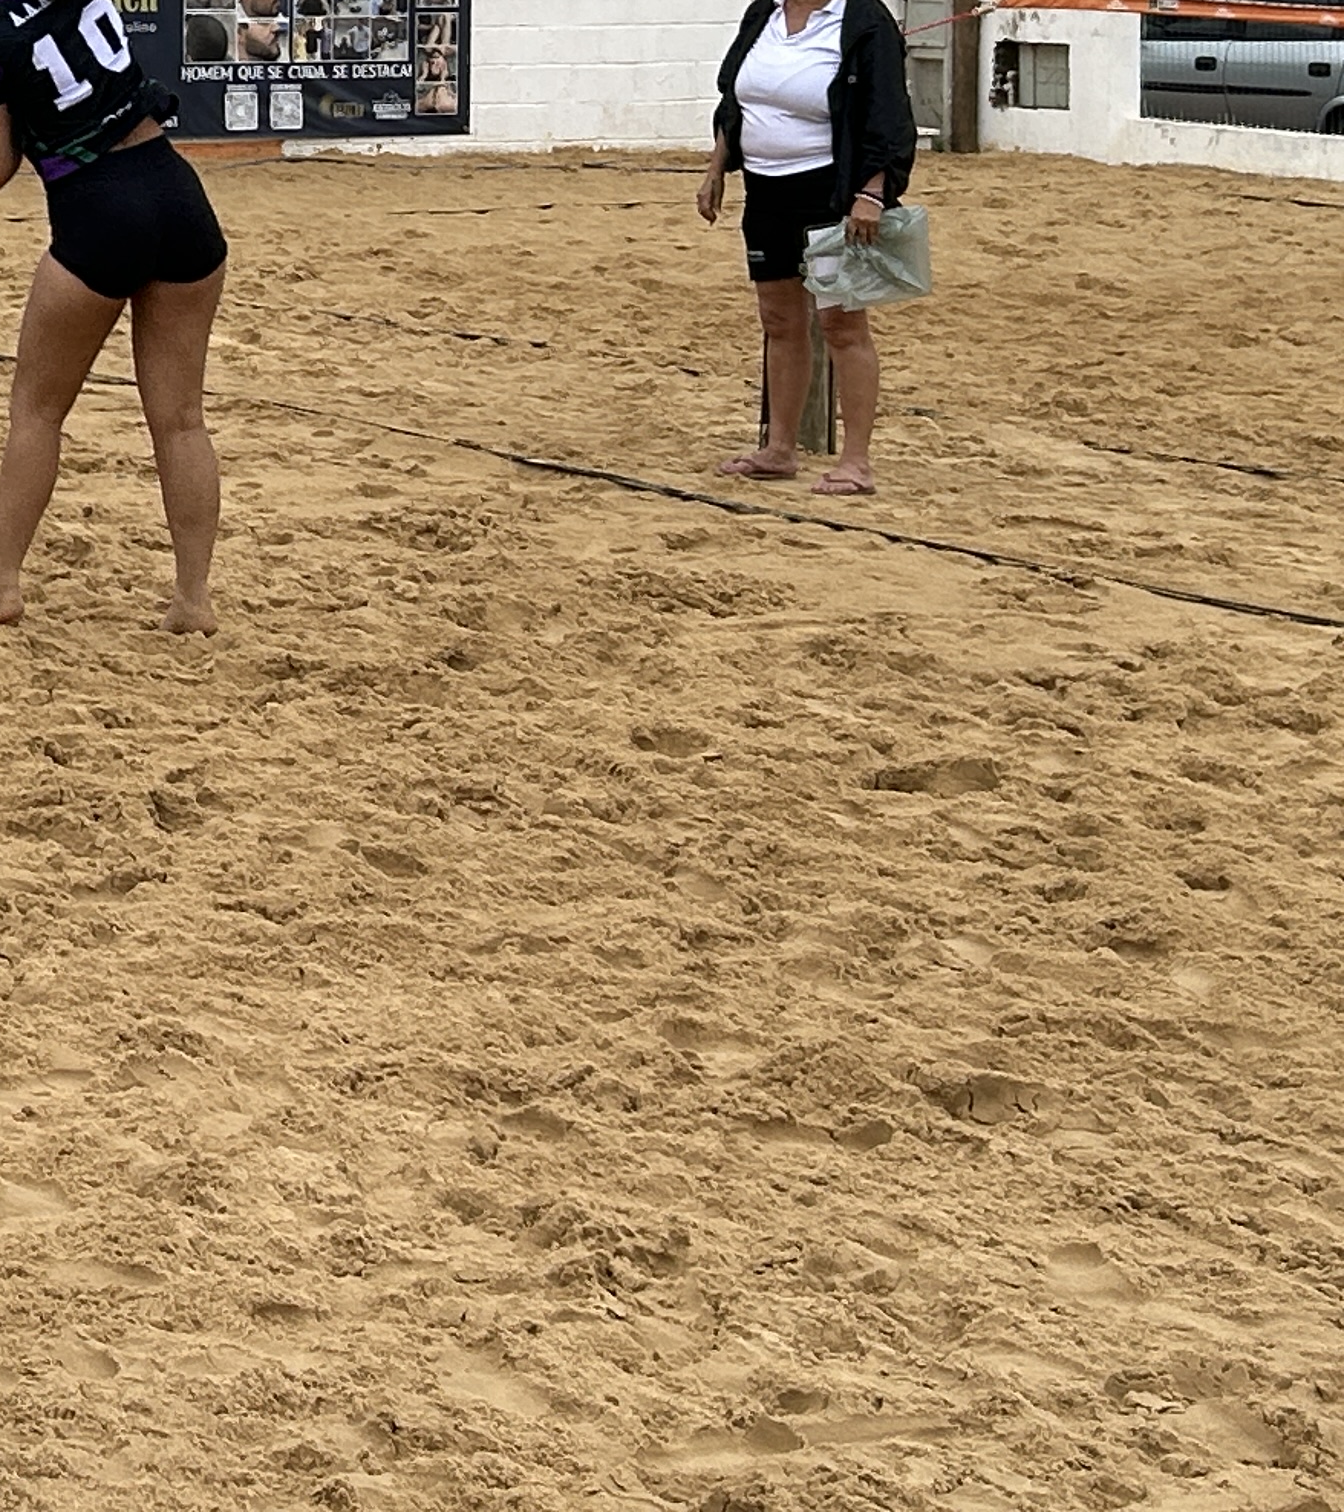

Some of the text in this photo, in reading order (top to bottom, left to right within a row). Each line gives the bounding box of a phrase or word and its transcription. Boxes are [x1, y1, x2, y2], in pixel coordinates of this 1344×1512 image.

[180, 65, 233, 82] HOMEM
[237, 65, 264, 82] QUE
[267, 65, 284, 79] SE
[332, 64, 348, 79] SE
[351, 63, 413, 79] DESTACA!
